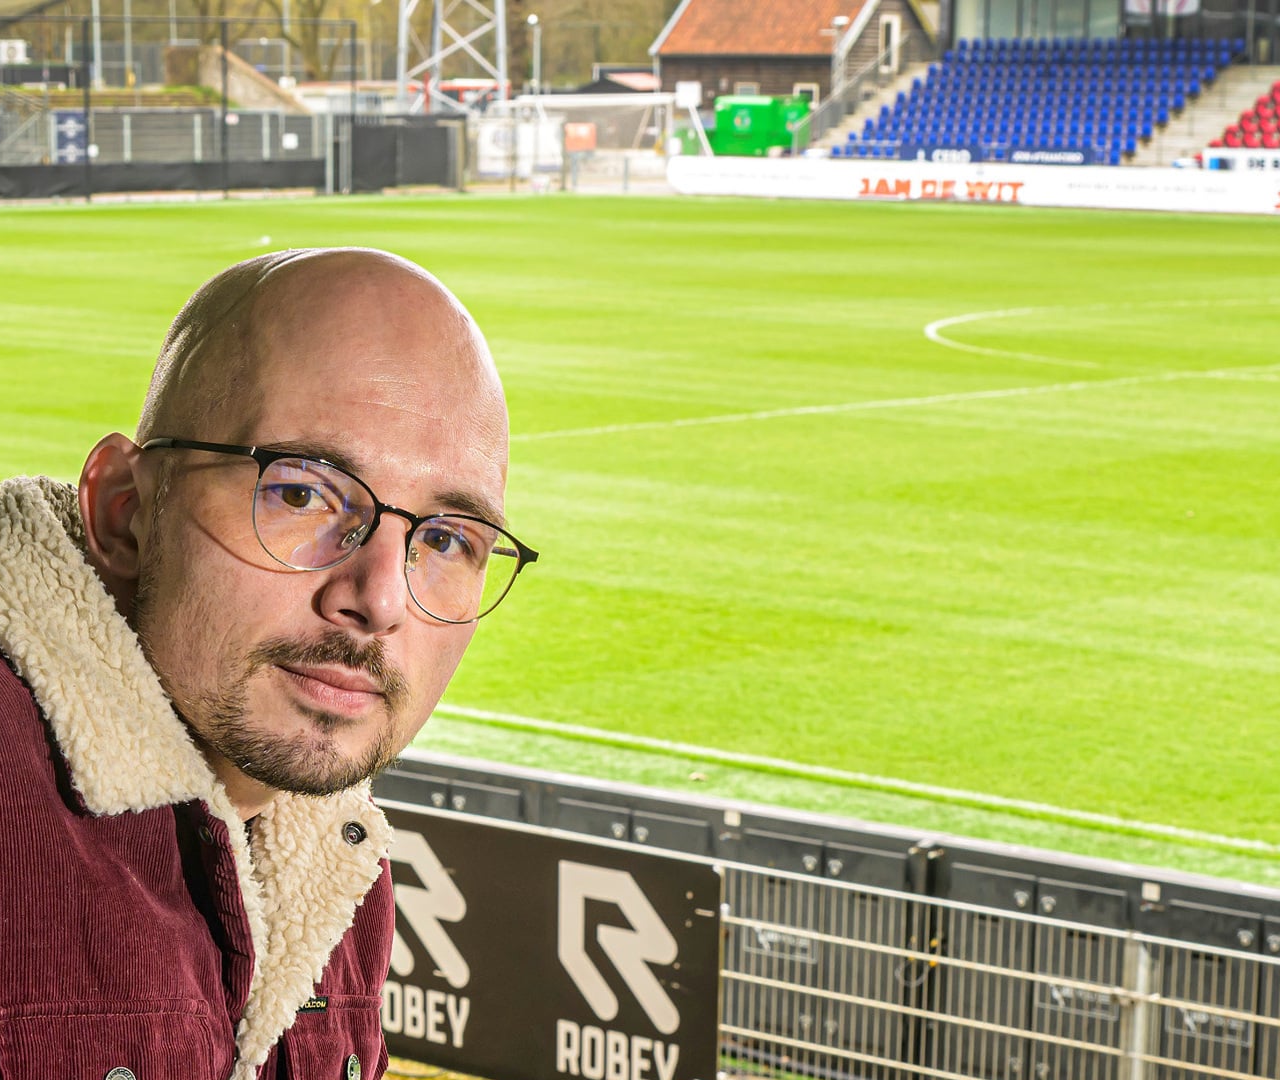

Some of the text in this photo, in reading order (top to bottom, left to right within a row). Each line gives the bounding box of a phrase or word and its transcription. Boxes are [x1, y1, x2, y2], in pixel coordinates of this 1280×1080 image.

[859, 178, 1024, 203] JAN DE WIT
[304, 1001, 327, 1009] OLCOM
[380, 979, 471, 1049] OBEY
